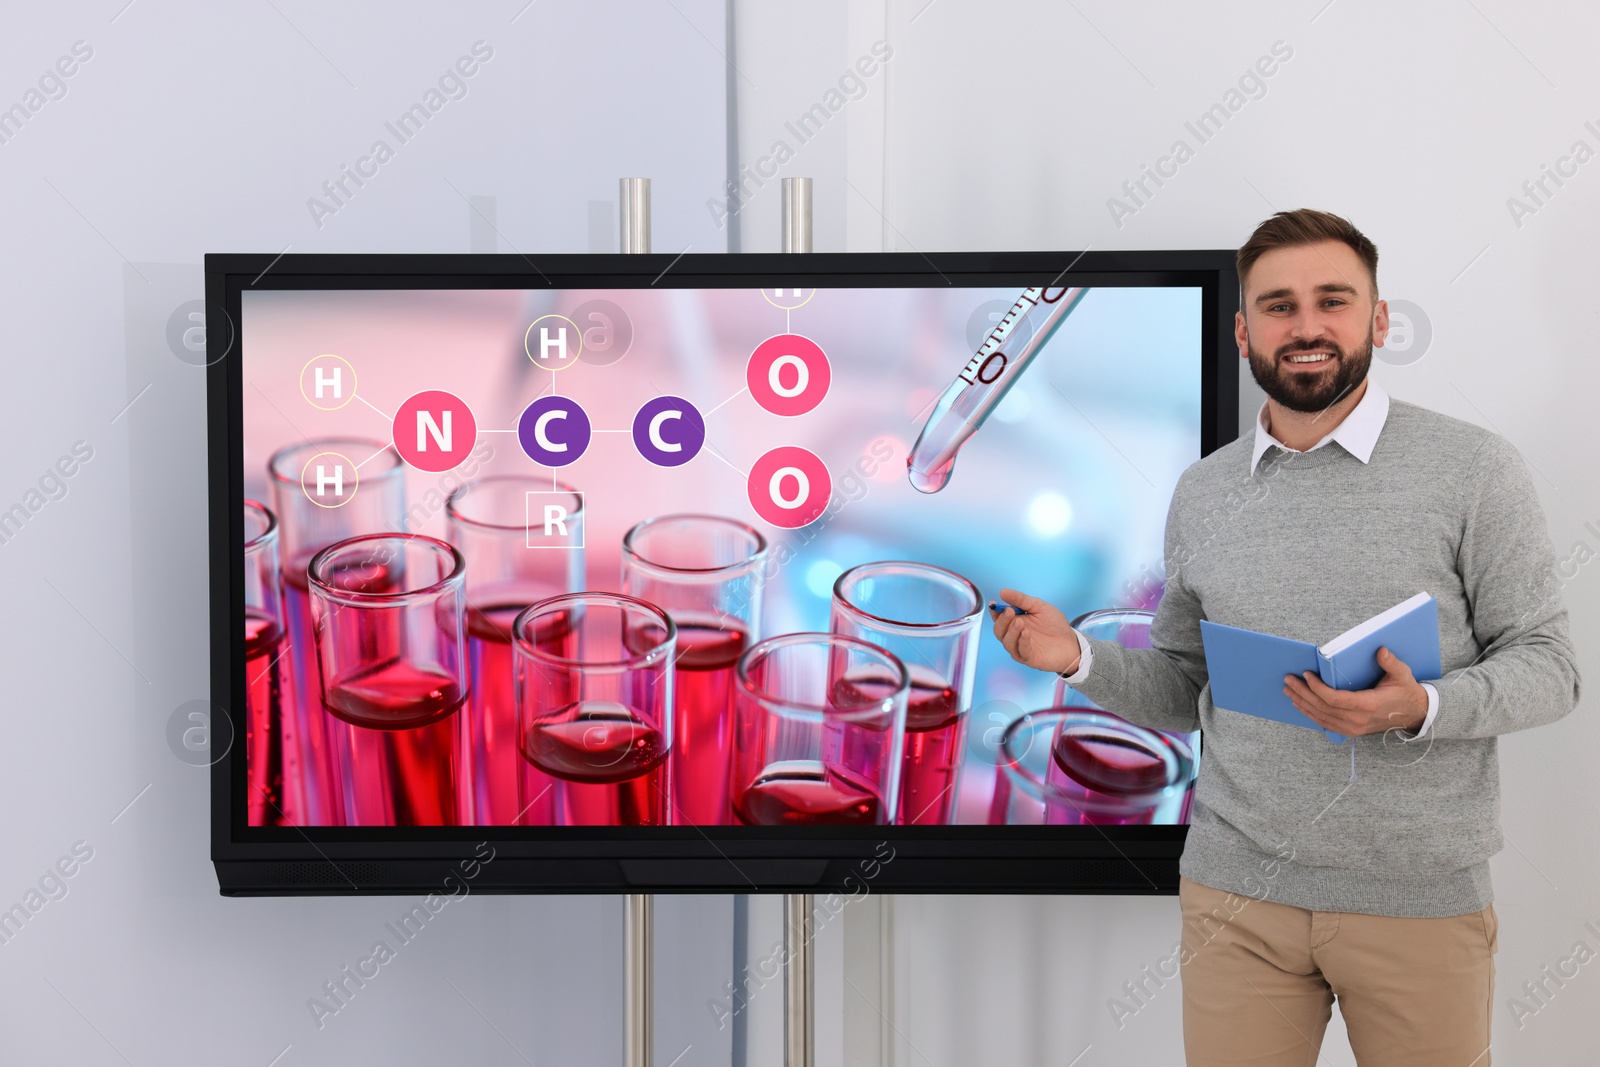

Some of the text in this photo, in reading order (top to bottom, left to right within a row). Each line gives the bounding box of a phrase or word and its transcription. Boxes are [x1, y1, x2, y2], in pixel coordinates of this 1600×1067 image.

[540, 328, 567, 359] H
[315, 367, 342, 398] H
[768, 355, 809, 398] O
[416, 410, 452, 452] N
[534, 410, 568, 453] C
[648, 410, 682, 453] C
[316, 465, 343, 496] H
[768, 466, 810, 510] O
[544, 505, 569, 536] R
